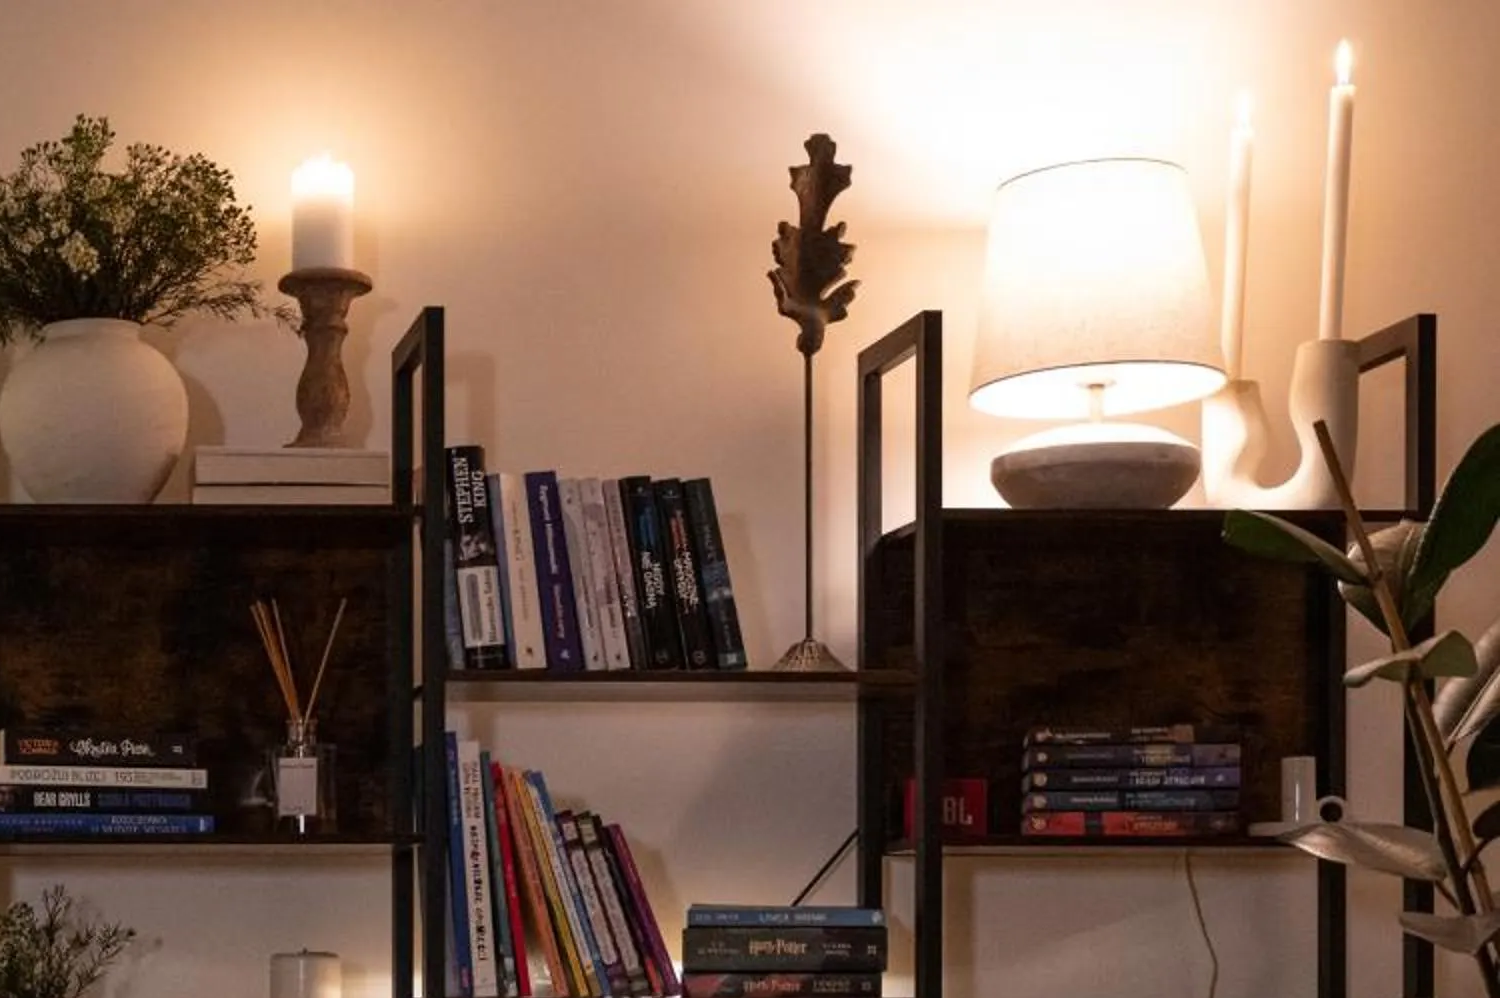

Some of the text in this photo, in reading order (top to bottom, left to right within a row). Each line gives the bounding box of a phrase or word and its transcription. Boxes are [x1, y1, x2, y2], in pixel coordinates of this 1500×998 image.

[452, 457, 474, 524] STEPHEN
[471, 470, 487, 508] KING
[33, 790, 57, 807] BEAR
[58, 791, 91, 808] GRYLLS
